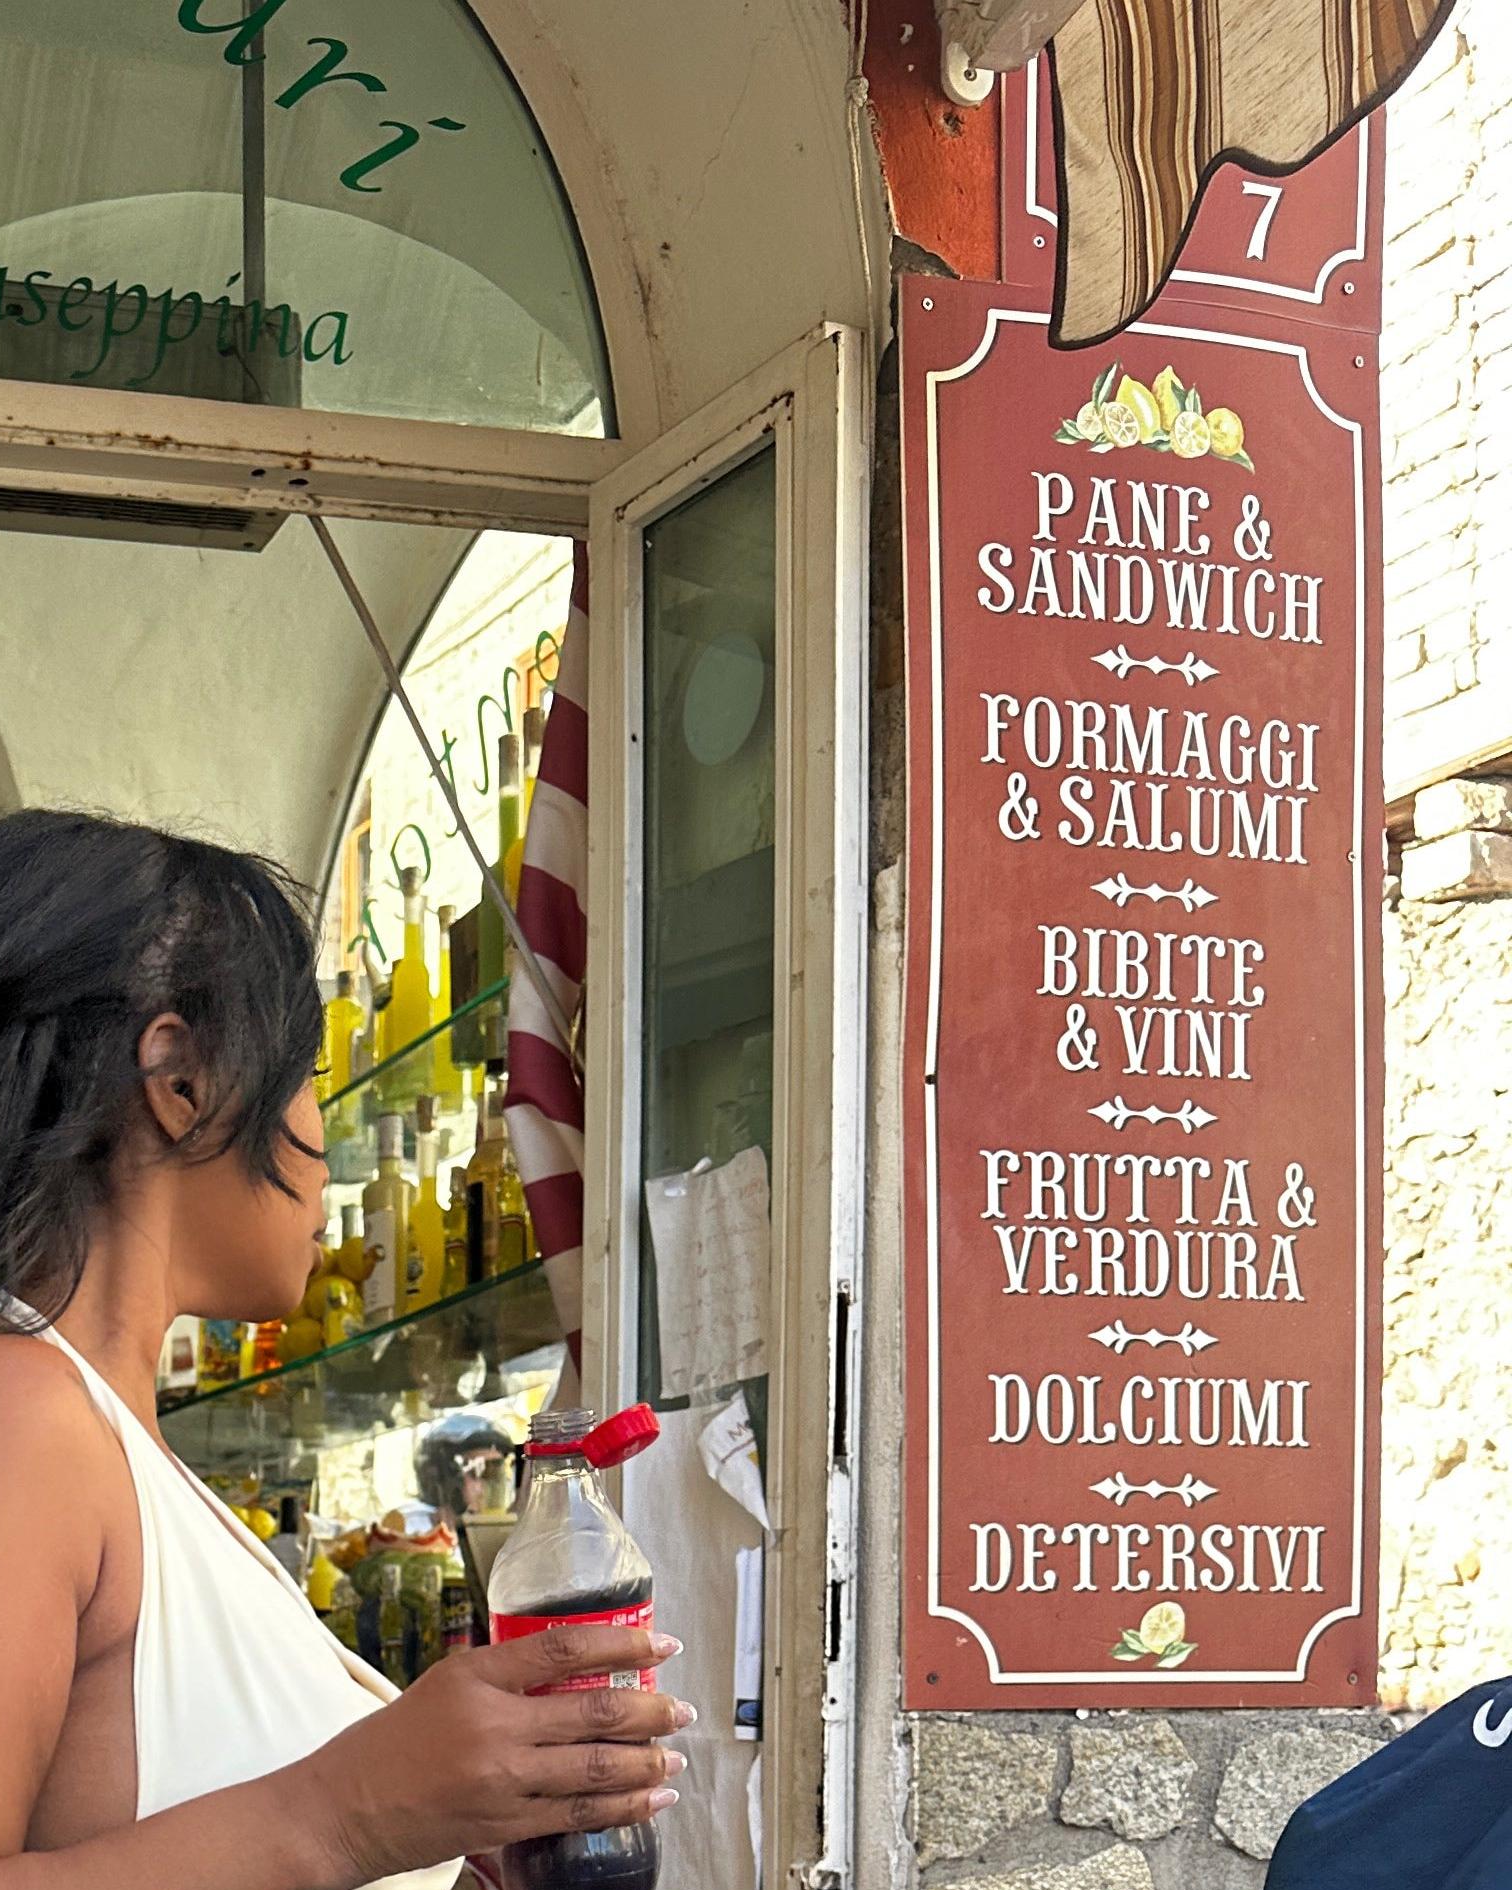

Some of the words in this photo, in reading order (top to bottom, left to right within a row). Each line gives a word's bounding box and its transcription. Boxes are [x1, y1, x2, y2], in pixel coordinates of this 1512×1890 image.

[1240, 180, 1283, 262] 7
[1030, 471, 1211, 556] PANE
[1233, 494, 1273, 562] &
[977, 542, 1323, 645] SANDWICH
[979, 693, 1320, 792] FORMAGGI
[998, 771, 1041, 841] &
[1058, 775, 1308, 865] SALUMI
[1036, 925, 1265, 1007] BIBITE
[1056, 1003, 1099, 1071] &
[1114, 1005, 1252, 1080] VINI
[979, 1149, 1259, 1227] FRUTTA
[1277, 1162, 1317, 1228] &
[993, 1225, 1305, 1302] VERDURA
[987, 1373, 1311, 1447] DOLCIUMI
[968, 1522, 1325, 1592] DETERSIVI
